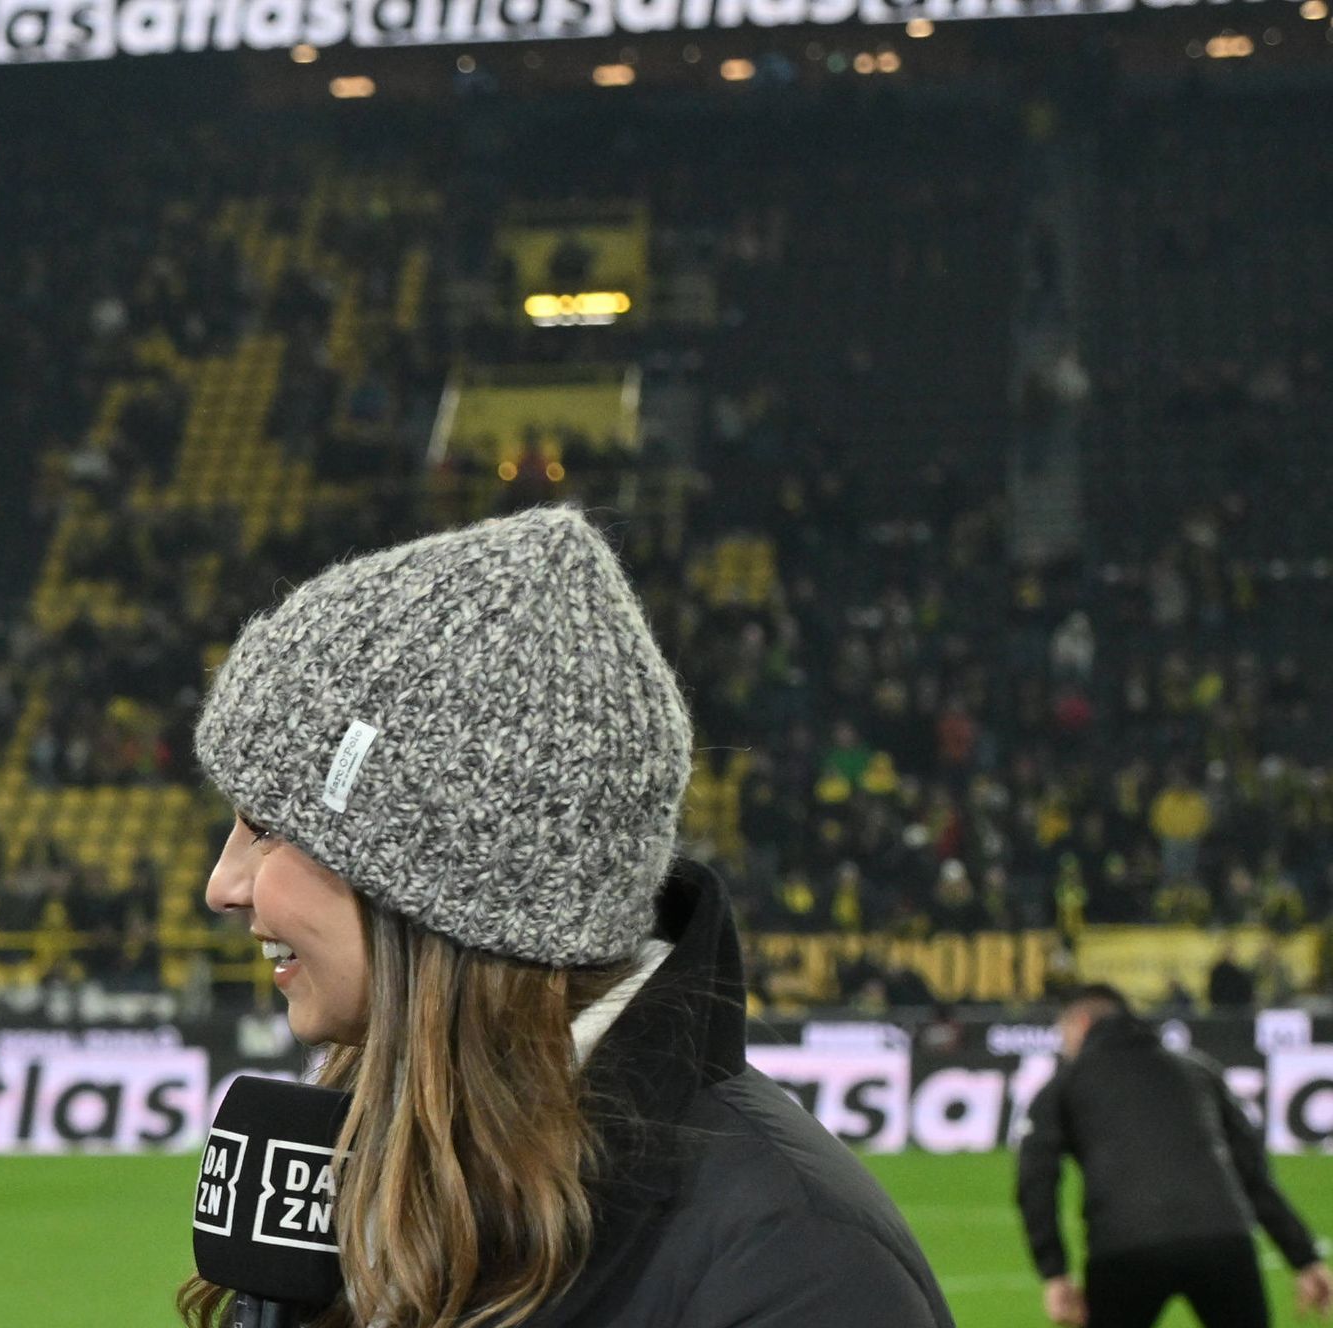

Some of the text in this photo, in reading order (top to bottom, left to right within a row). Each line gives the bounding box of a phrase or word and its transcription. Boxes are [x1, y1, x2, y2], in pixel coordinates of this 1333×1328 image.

[203, 1145, 228, 1179] DA
[285, 1159, 336, 1197] DA
[198, 1181, 223, 1216] ZN
[279, 1197, 332, 1234] ZN
